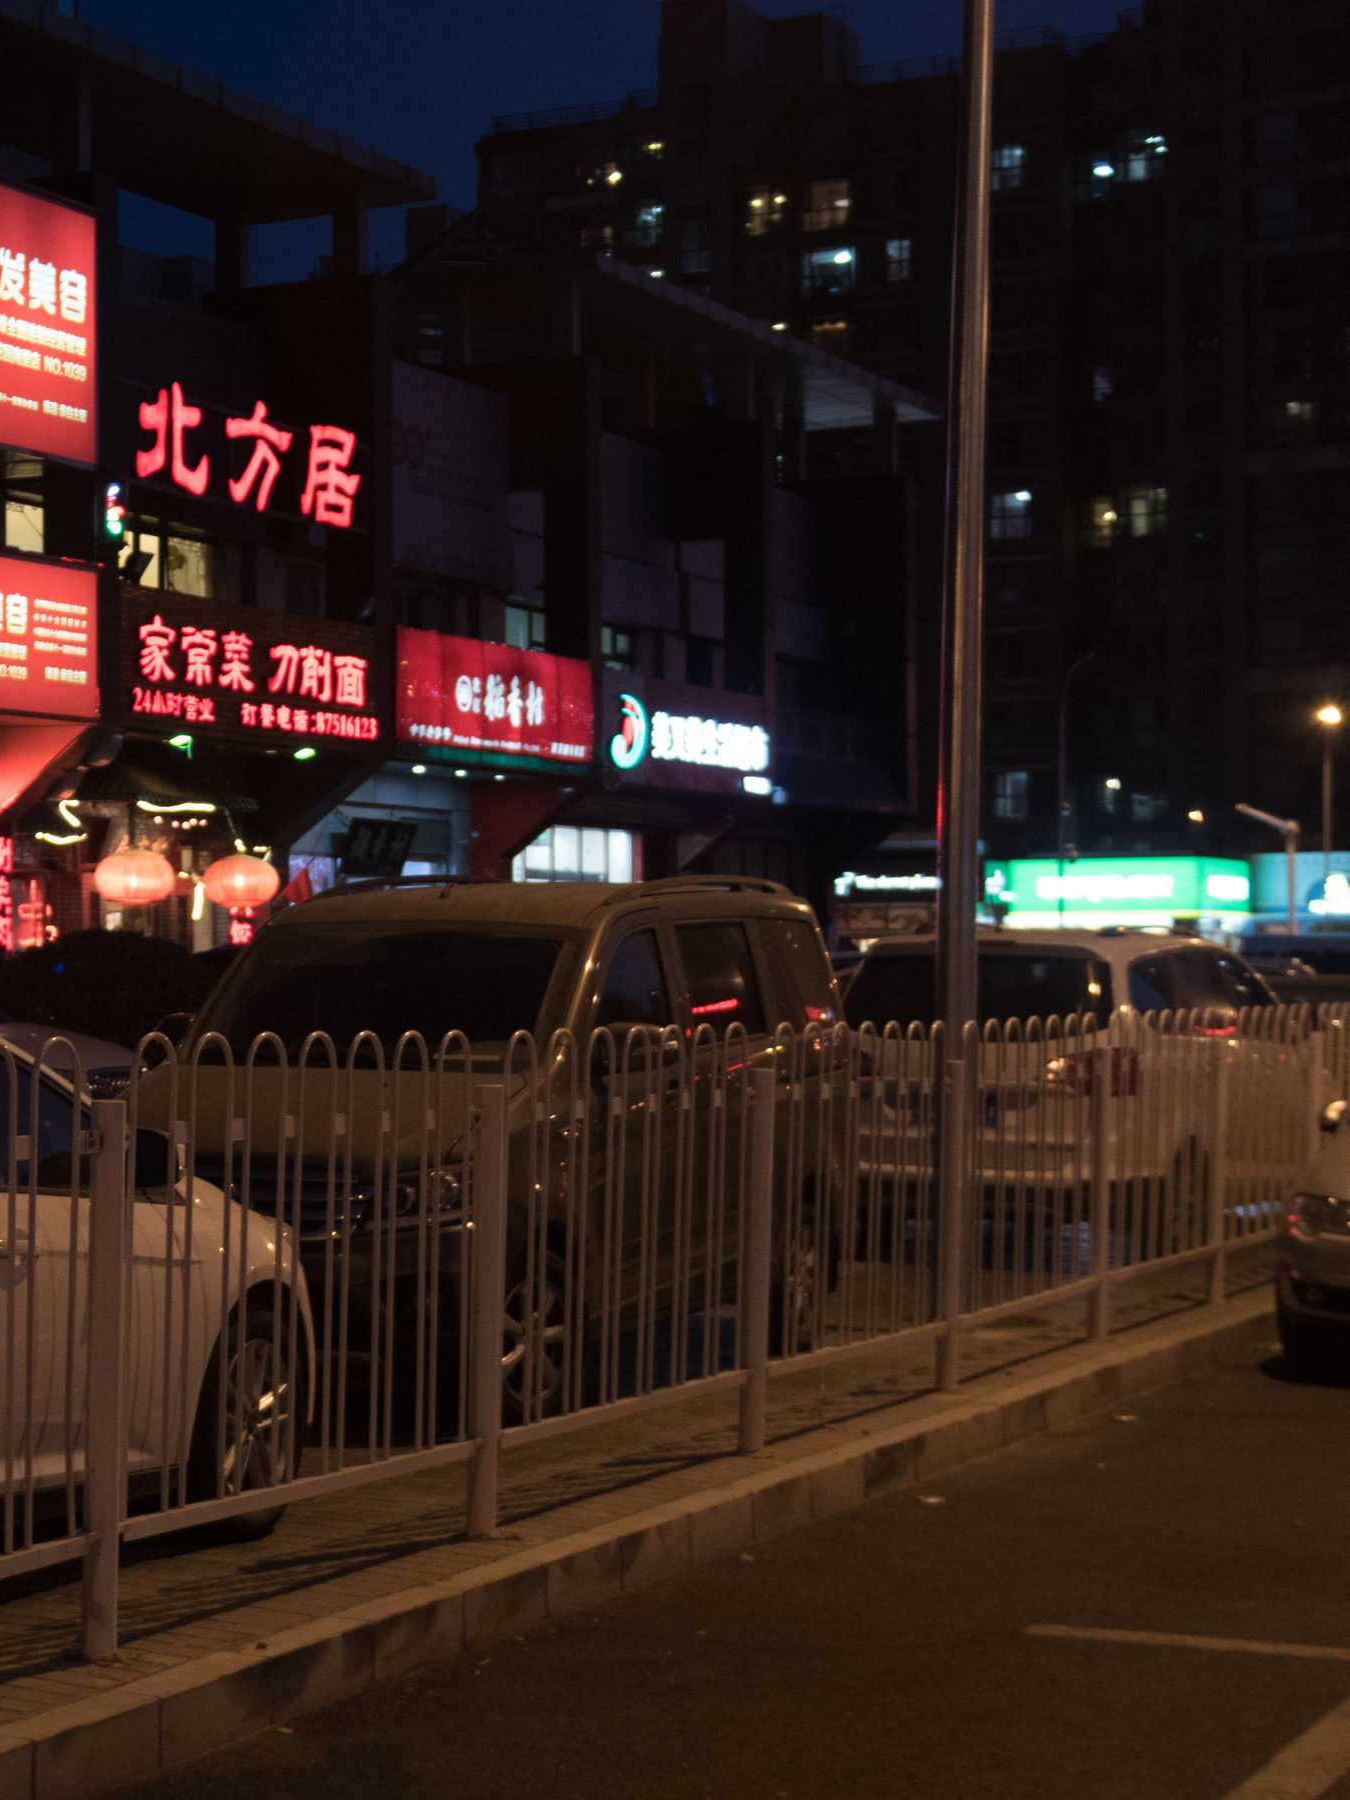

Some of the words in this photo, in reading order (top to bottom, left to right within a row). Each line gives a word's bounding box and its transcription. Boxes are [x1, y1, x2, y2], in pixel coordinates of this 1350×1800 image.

[136, 381, 361, 528] 北方居
[139, 614, 254, 692] 家常菜
[268, 644, 368, 707] 刀削面
[132, 687, 216, 723] 24小时营业
[484, 673, 544, 727] 稻香村
